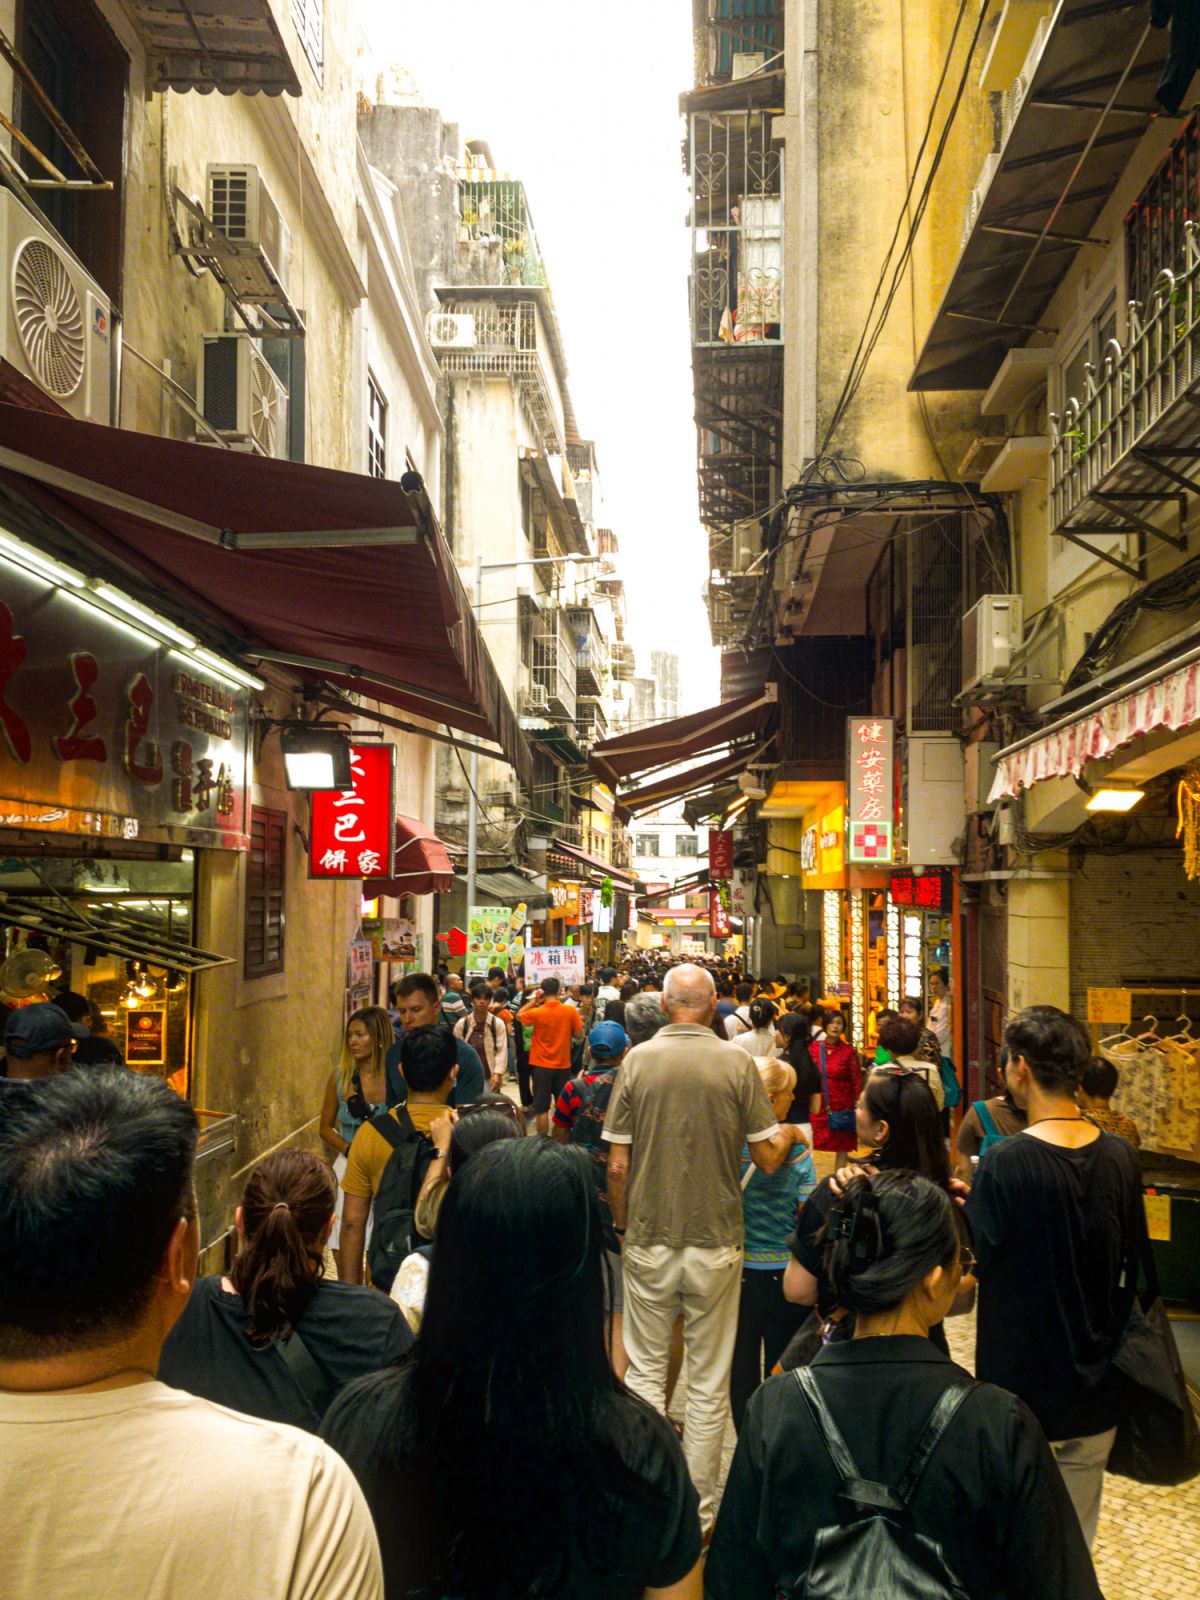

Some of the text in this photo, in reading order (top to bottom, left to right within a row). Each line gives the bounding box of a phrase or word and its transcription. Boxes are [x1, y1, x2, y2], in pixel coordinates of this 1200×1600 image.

[320, 848, 382, 874] 餅家
[530, 949, 577, 966] 冰箱貼
